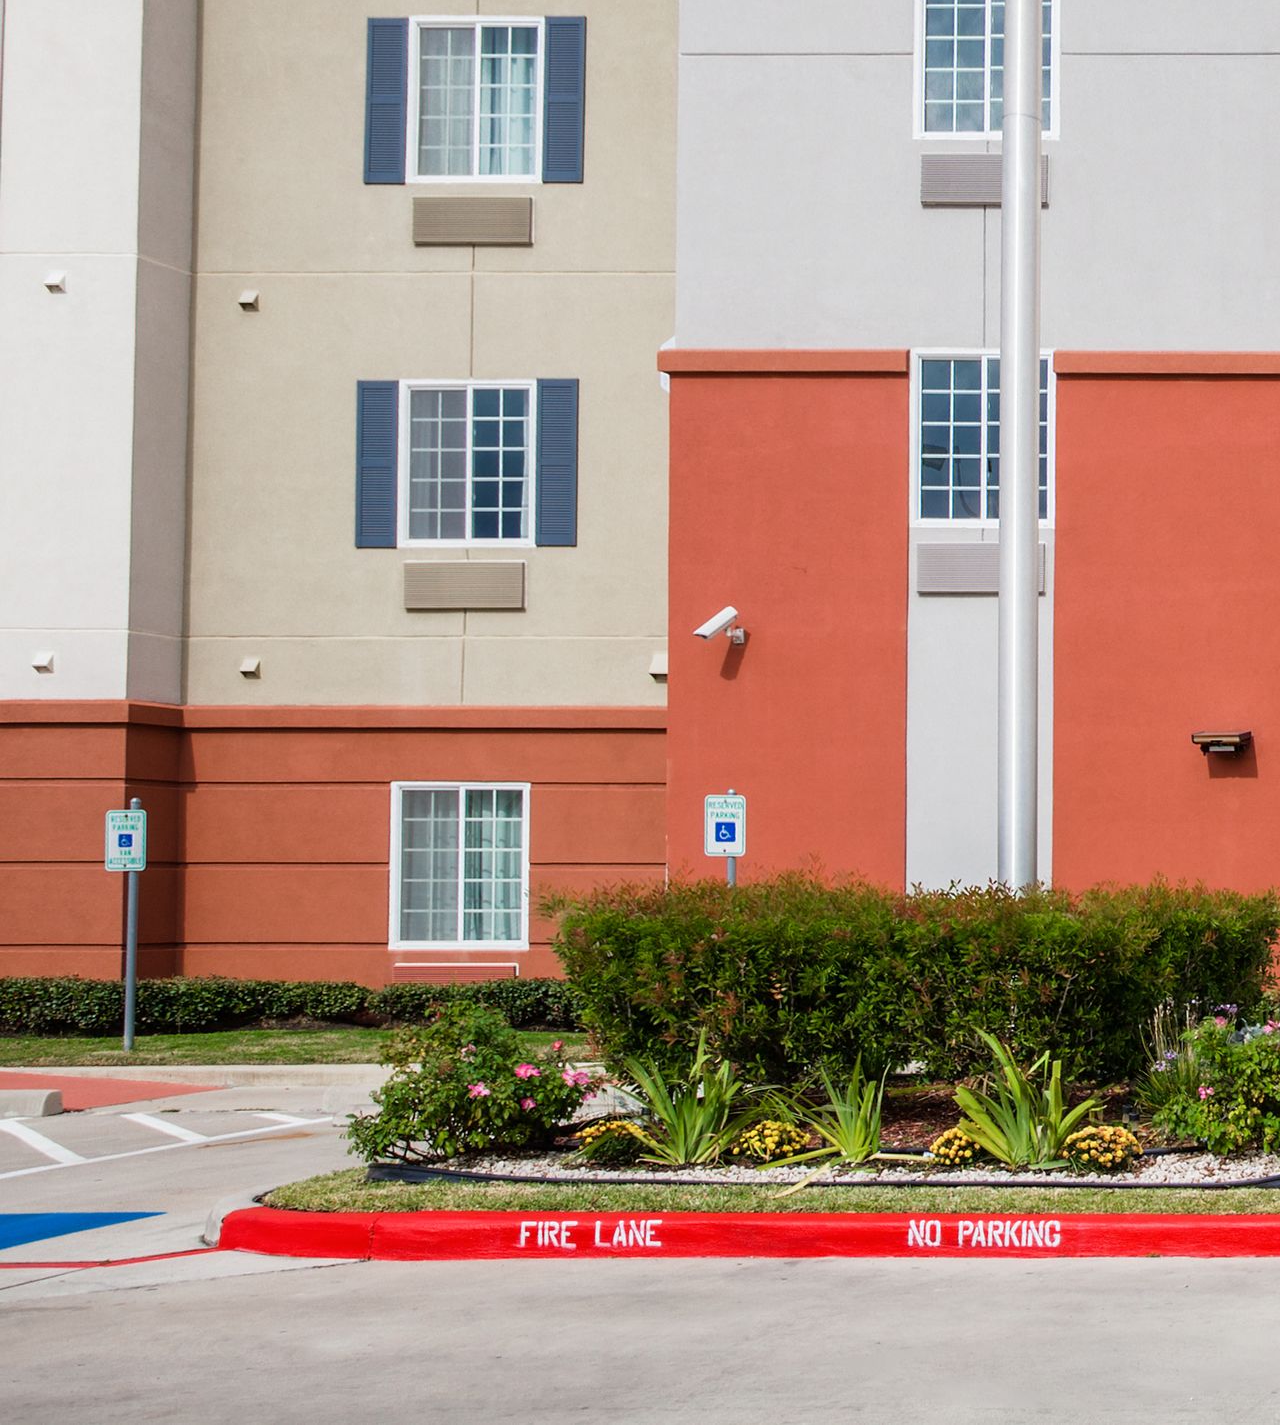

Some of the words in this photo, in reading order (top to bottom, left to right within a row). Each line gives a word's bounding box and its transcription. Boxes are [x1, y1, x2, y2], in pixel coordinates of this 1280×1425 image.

[708, 801, 744, 809] RESERVED
[111, 815, 141, 823] RESERVED
[710, 811, 740, 819] PARKING
[517, 1221, 577, 1249] FIRE
[594, 1220, 662, 1247] LANE
[907, 1220, 941, 1247] NO
[958, 1220, 1062, 1247] PARKING
